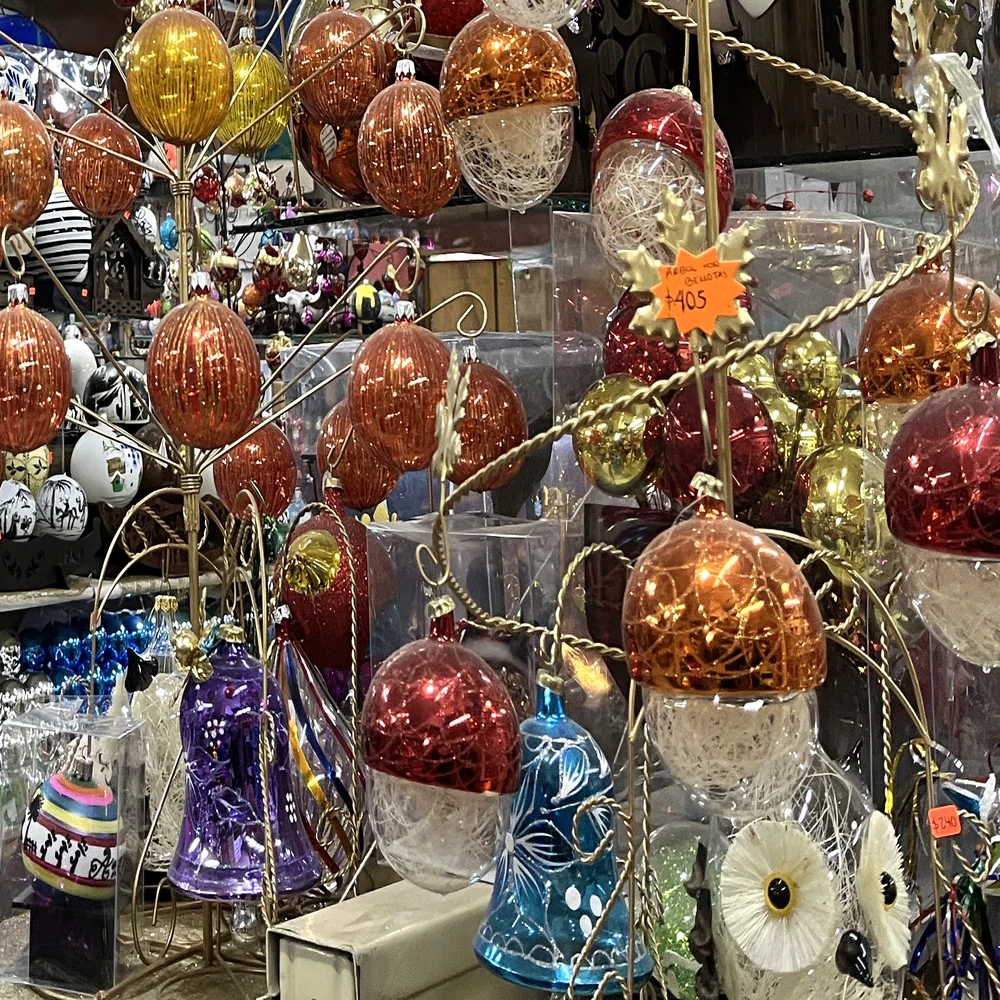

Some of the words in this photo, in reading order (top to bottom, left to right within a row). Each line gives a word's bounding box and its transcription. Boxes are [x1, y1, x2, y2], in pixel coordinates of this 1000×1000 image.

[684, 270, 728, 287] BELLOTAS
[664, 286, 708, 314] $405
[932, 815, 958, 830] $240
